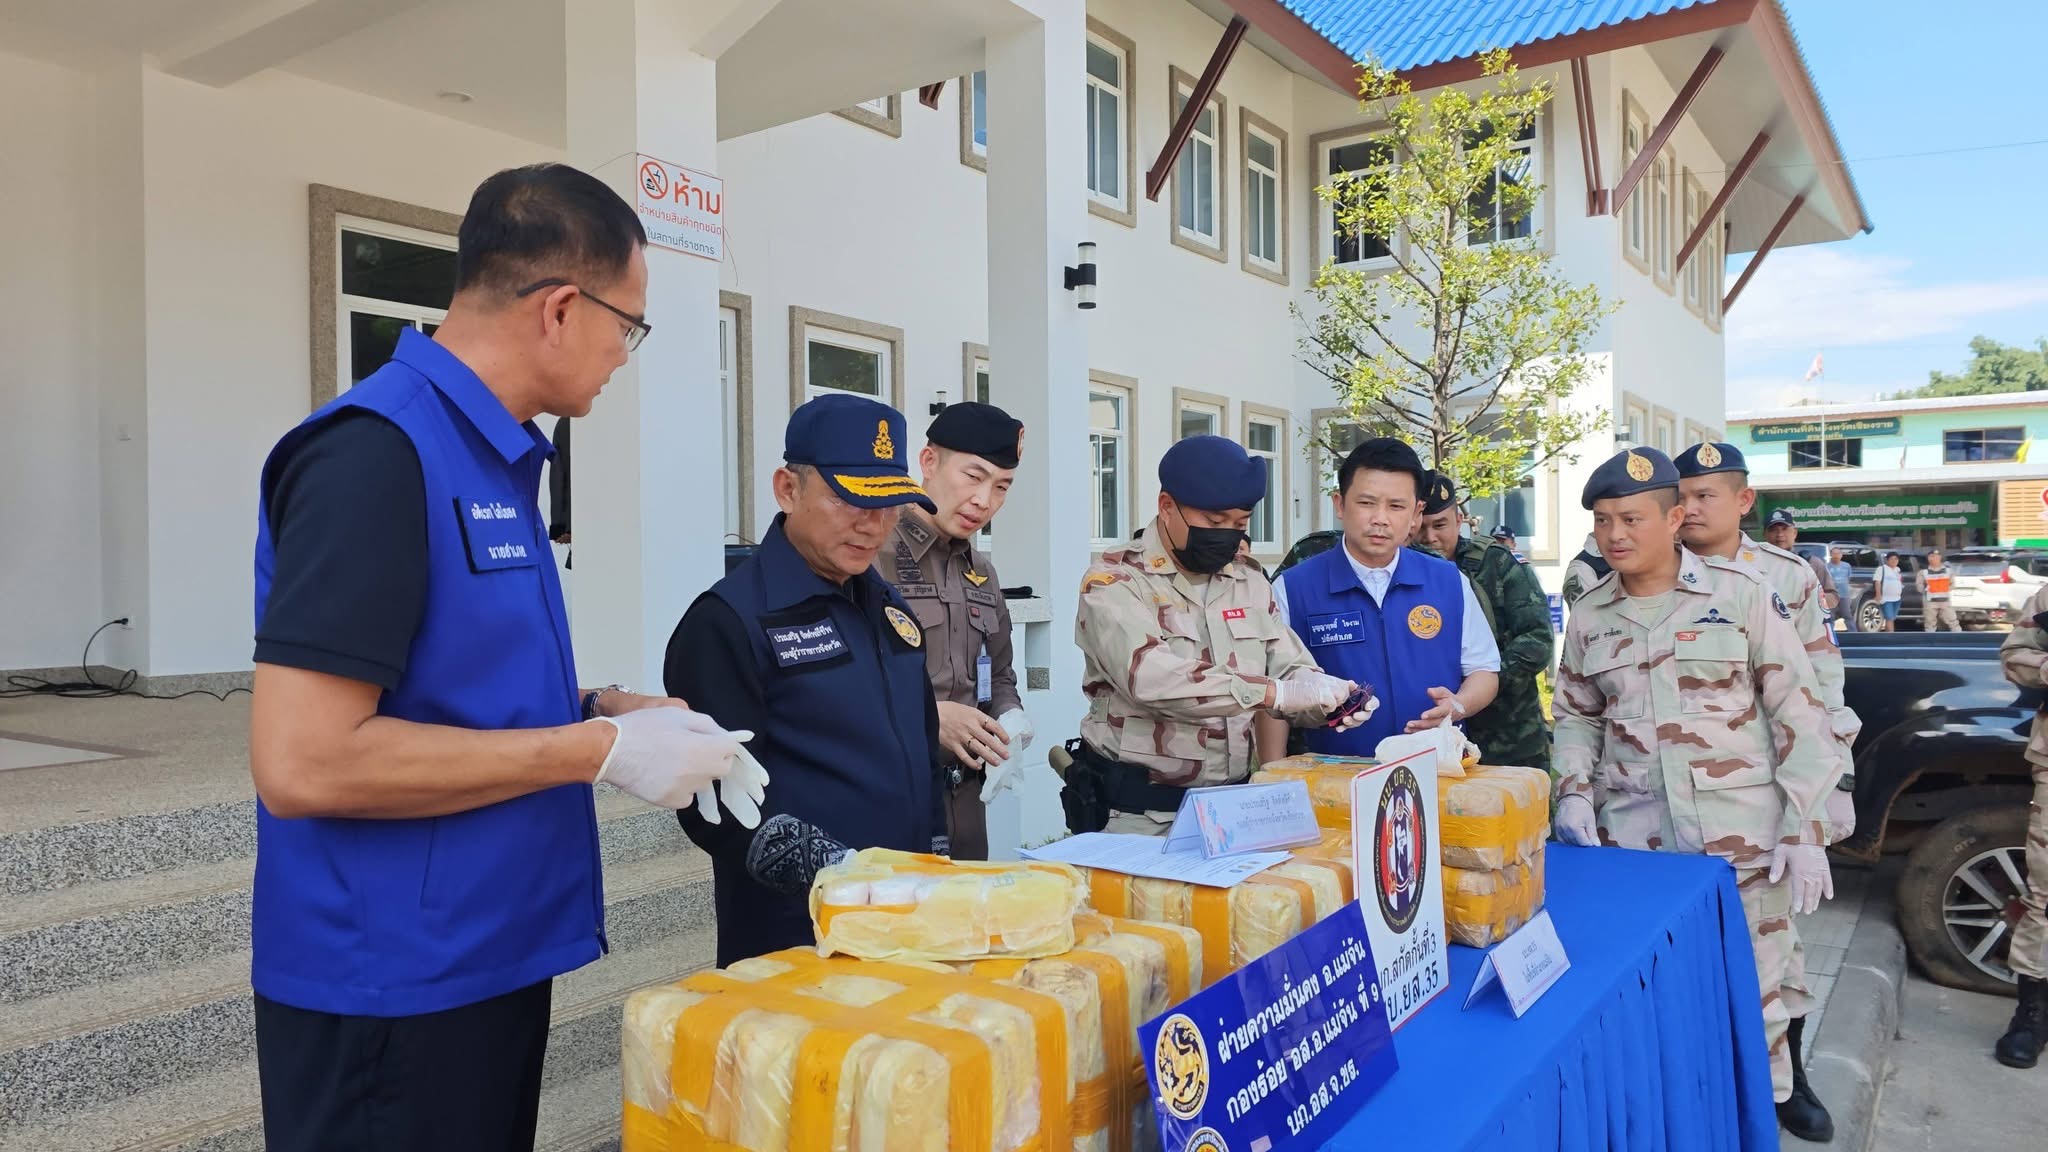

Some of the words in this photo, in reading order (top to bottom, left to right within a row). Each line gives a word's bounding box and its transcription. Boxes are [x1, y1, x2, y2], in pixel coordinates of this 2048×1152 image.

[674, 172, 721, 215] ห้าม
[640, 202, 722, 236] จำหน่ายสินค้าทุกชนิด
[647, 226, 715, 256] ในสถานที่ราชการ
[1217, 973, 1321, 1064] ฝ่ายความมั่นคง
[1322, 936, 1367, 987] อ.แม่จัน
[1226, 1058, 1288, 1124] กองร้อย
[1290, 997, 1359, 1072] อส.อ.แม่จัน
[1357, 973, 1371, 1013] ที่
